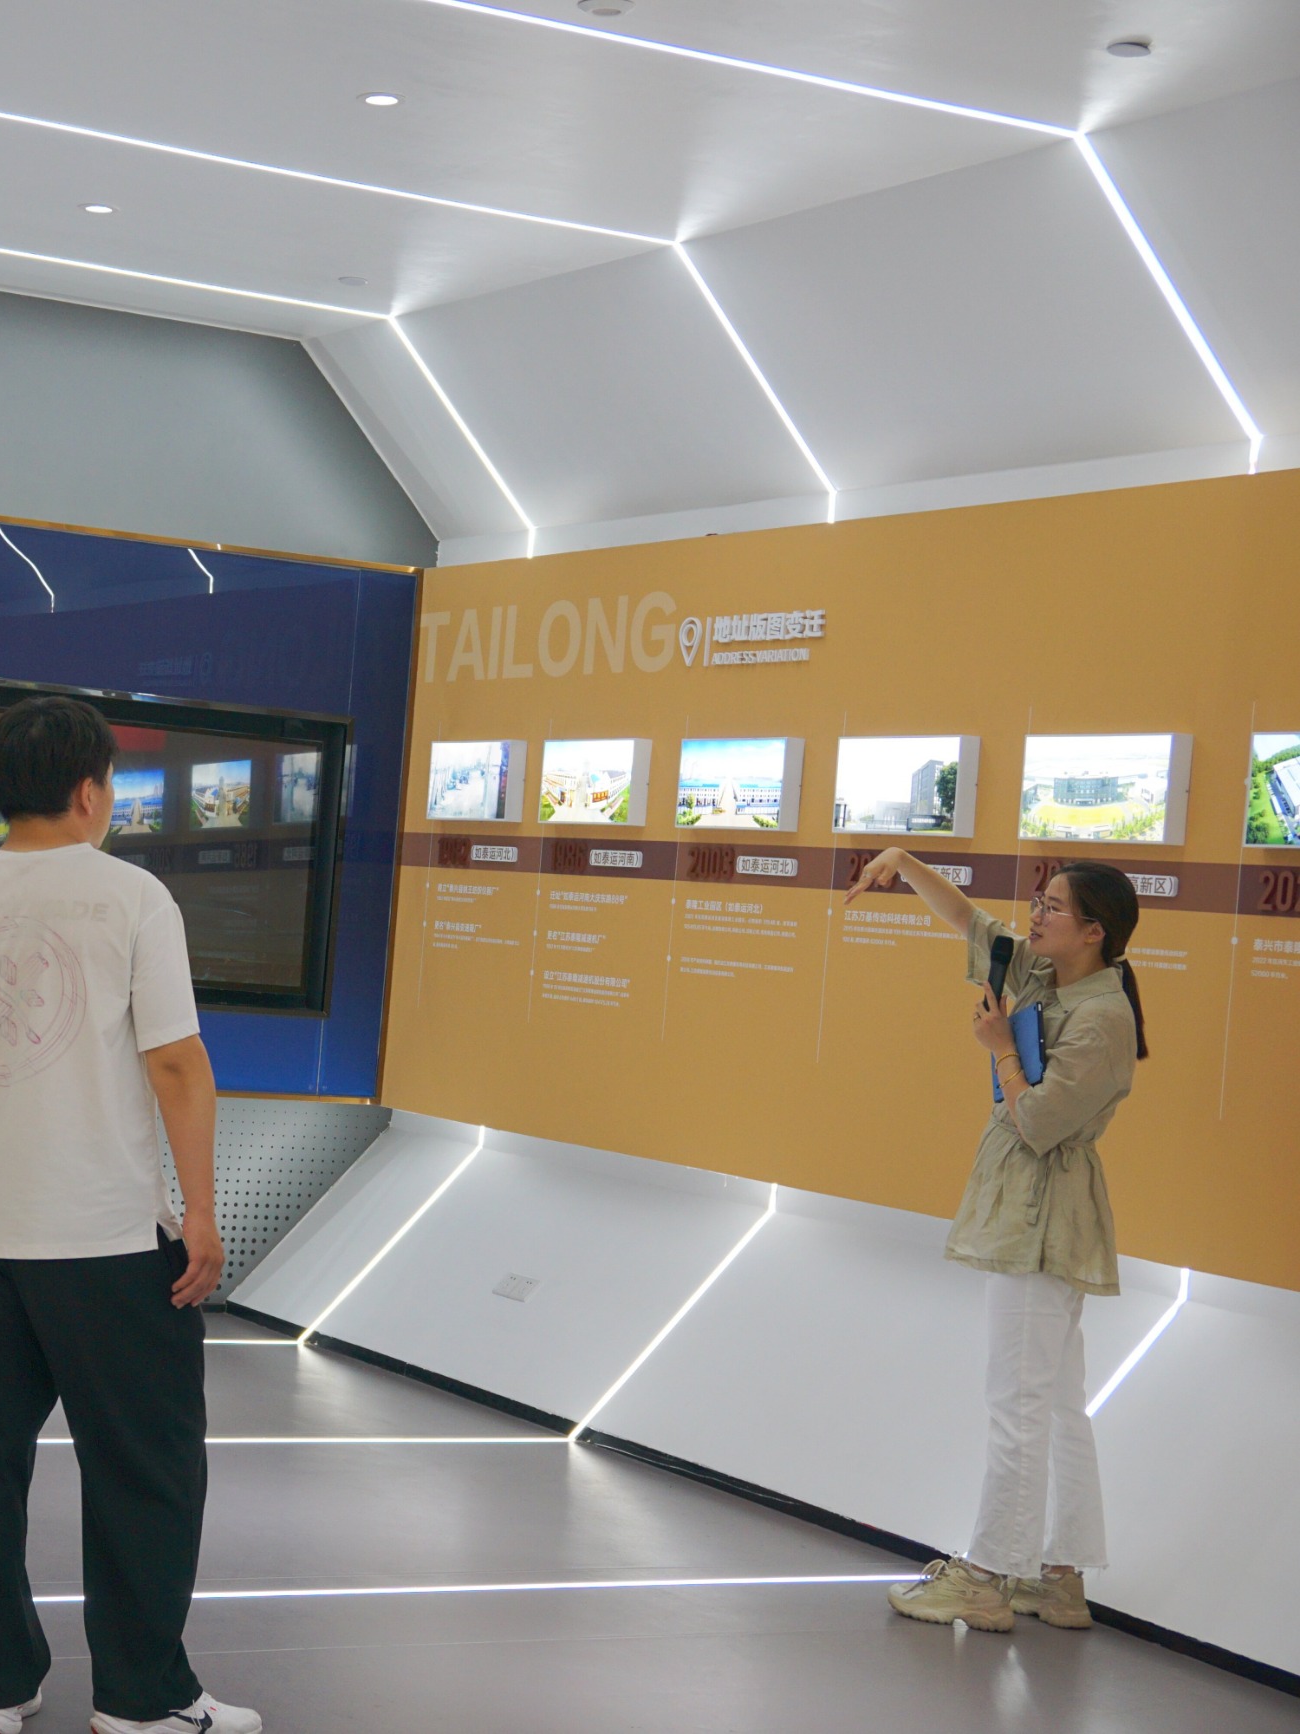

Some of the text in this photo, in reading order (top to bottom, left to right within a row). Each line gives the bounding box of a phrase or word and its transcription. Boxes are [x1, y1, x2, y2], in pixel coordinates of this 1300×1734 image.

[420, 591, 677, 684] TAILONG
[713, 609, 825, 643] 地址版图变迁
[712, 648, 810, 665] ADDRESS VARIATION
[553, 840, 589, 873] 1986
[687, 847, 736, 881] 2003
